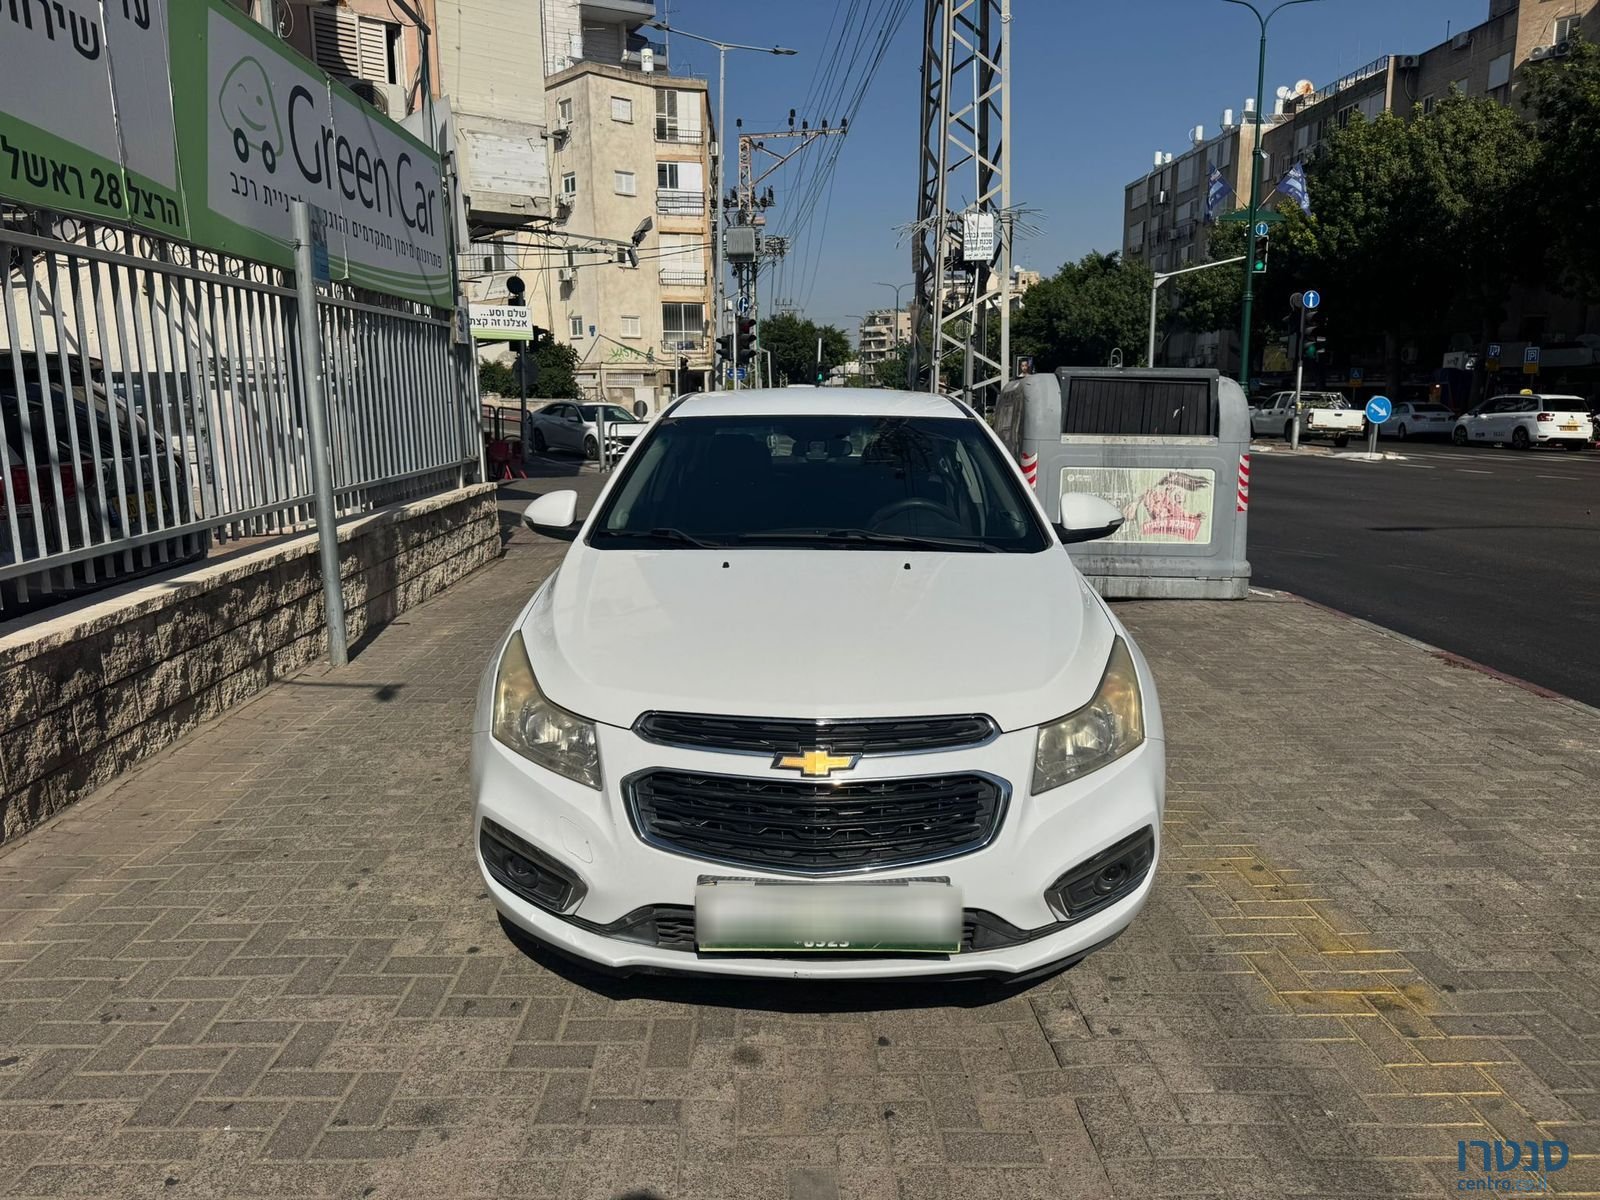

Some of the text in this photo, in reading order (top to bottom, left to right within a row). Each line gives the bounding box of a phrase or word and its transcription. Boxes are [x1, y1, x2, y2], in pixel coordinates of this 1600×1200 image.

[90, 167, 122, 210] 28
[229, 171, 259, 201] רכב
[396, 152, 436, 237] Car
[126, 176, 181, 228] הרצל
[351, 220, 393, 251] מתקדמים
[394, 237, 415, 259] מימון
[490, 319, 501, 327] זה
[503, 317, 528, 328] אצלנו
[507, 309, 527, 318] שלם
